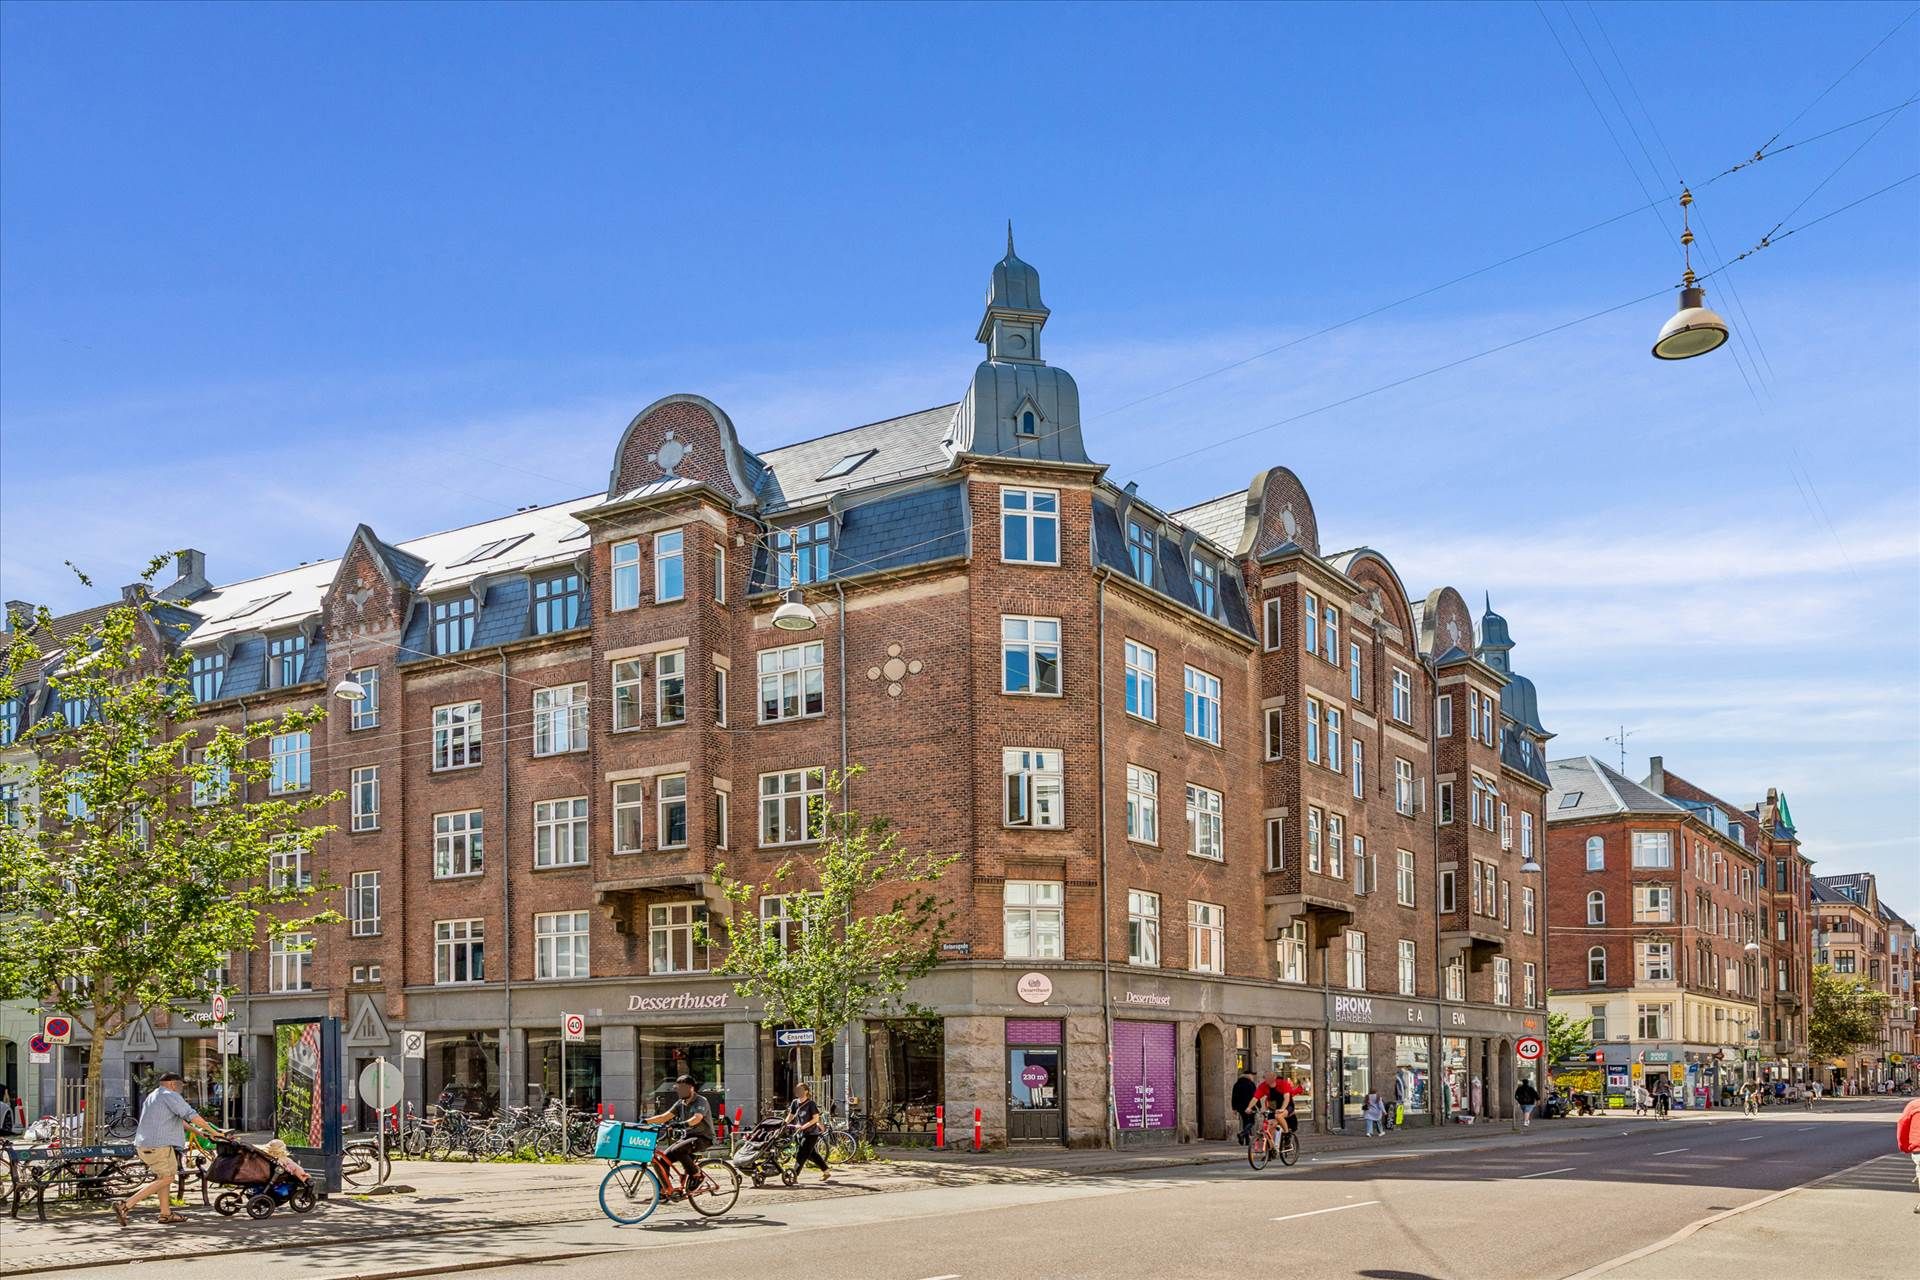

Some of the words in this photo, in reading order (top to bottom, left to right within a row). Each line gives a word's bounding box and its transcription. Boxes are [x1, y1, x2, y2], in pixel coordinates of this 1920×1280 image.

[627, 992, 729, 1011] Desserthuset
[1126, 991, 1170, 1006] Desserthuset
[1335, 996, 1372, 1014] BRONX
[1335, 1010, 1373, 1024] BARBERS
[1452, 1012, 1466, 1025] EVA
[570, 1021, 580, 1029] 40
[1521, 1045, 1538, 1053] 40
[629, 1136, 651, 1147] Wolt
